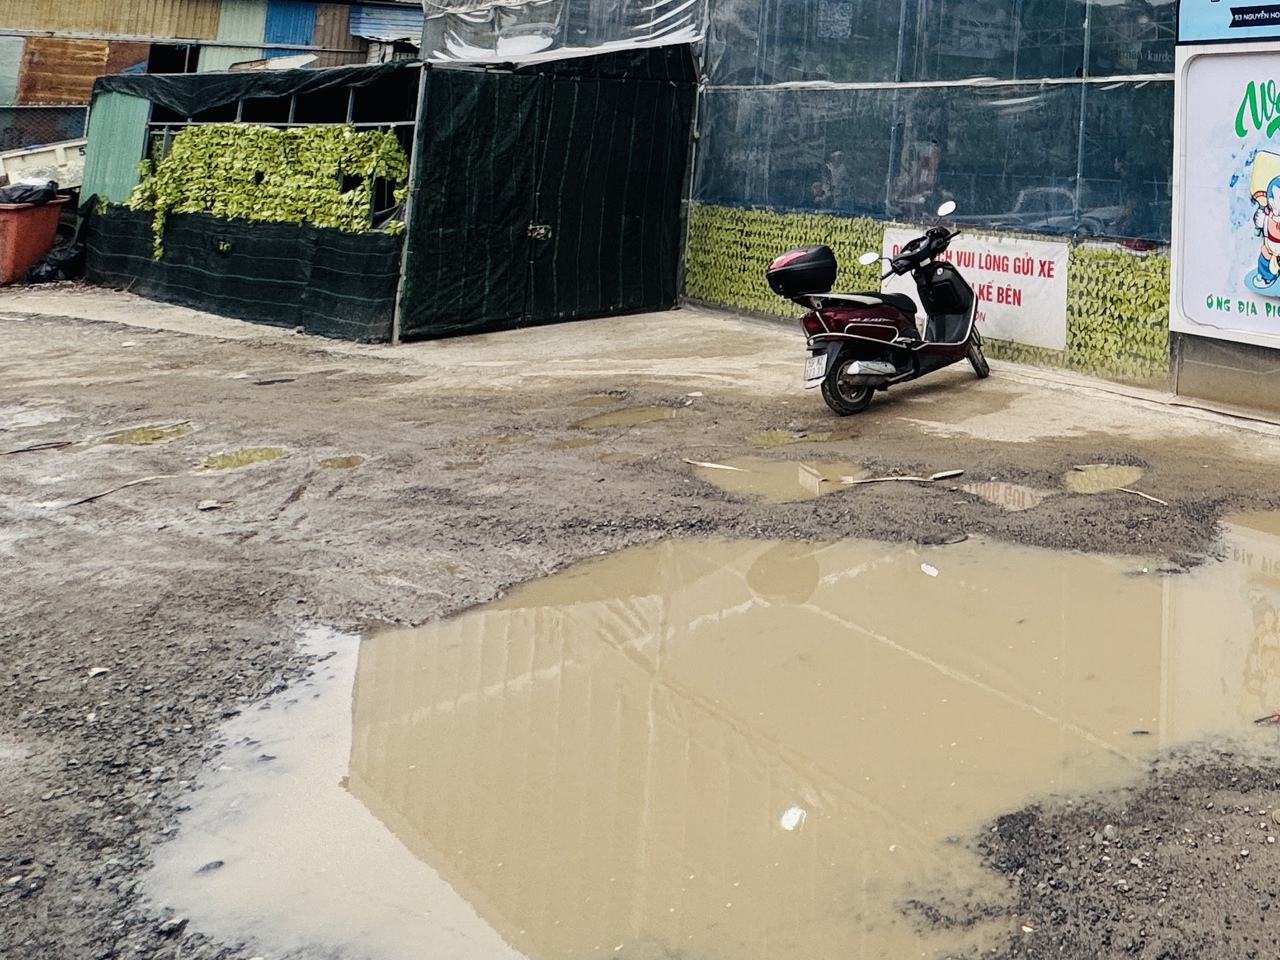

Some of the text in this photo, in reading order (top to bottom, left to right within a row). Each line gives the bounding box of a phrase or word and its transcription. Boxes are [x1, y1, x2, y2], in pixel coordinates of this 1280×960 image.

[956, 250, 975, 268] VUI
[978, 249, 1009, 273] LÒNG
[1013, 252, 1034, 276] GỬI
[1038, 259, 1055, 278] XE
[978, 280, 1022, 306] KẾ BÊN
